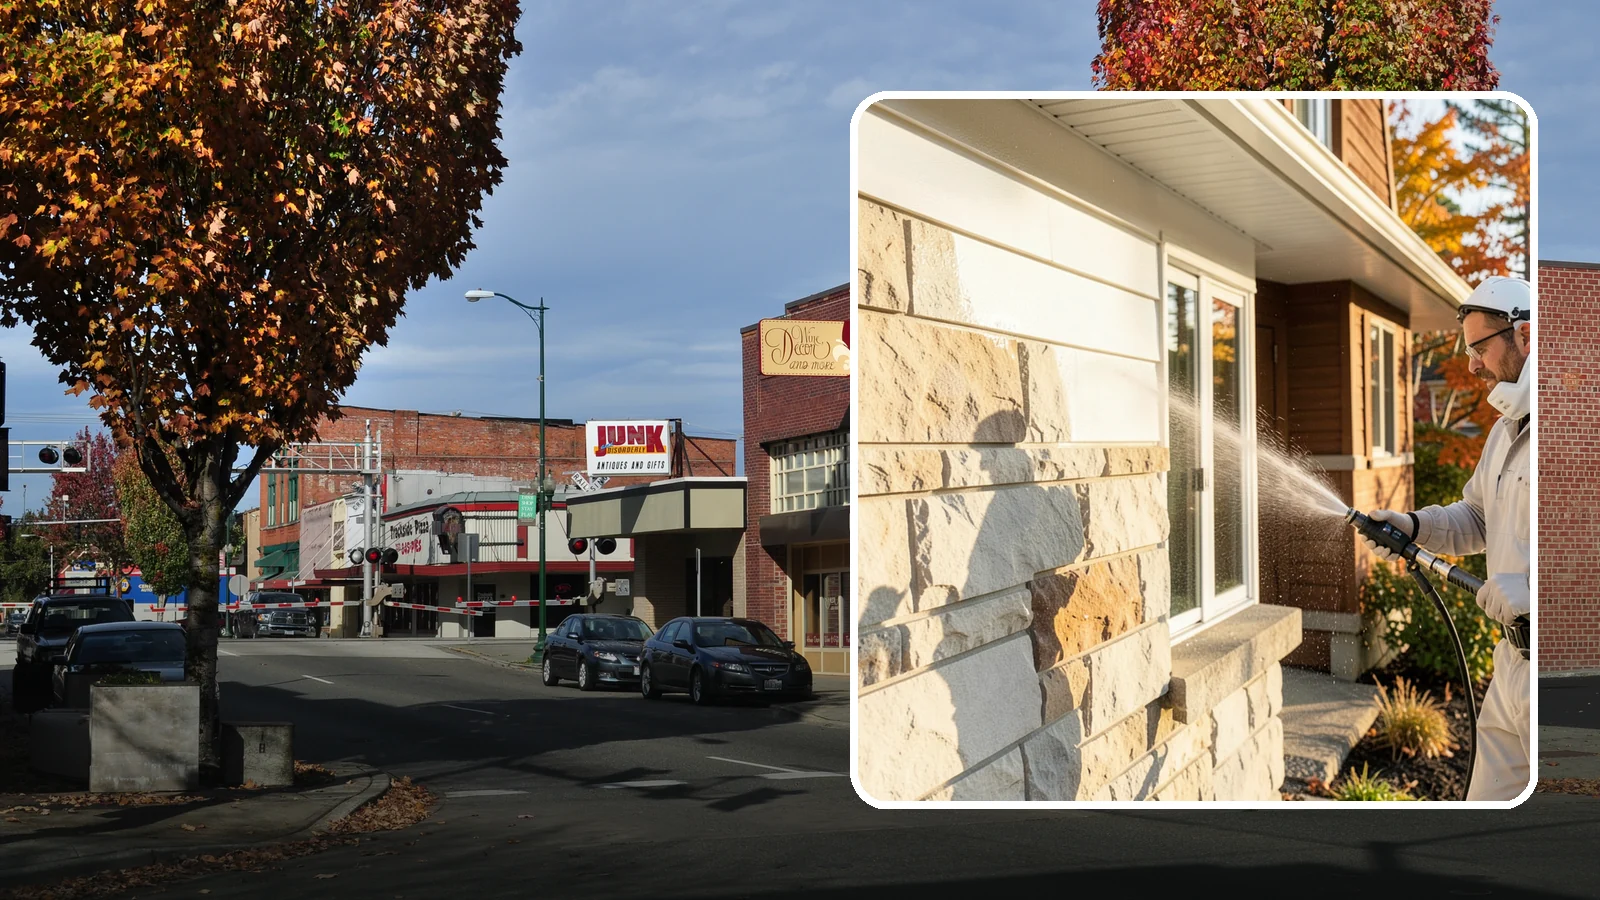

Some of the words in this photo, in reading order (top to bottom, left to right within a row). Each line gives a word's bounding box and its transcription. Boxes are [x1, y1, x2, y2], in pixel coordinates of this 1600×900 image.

[595, 425, 664, 457] JUNK
[607, 446, 646, 454] DISORDERLY
[597, 461, 628, 470] ANTIQUES
[631, 461, 644, 470] AND
[647, 460, 666, 470] GIFTS
[414, 520, 429, 535] Pizza
